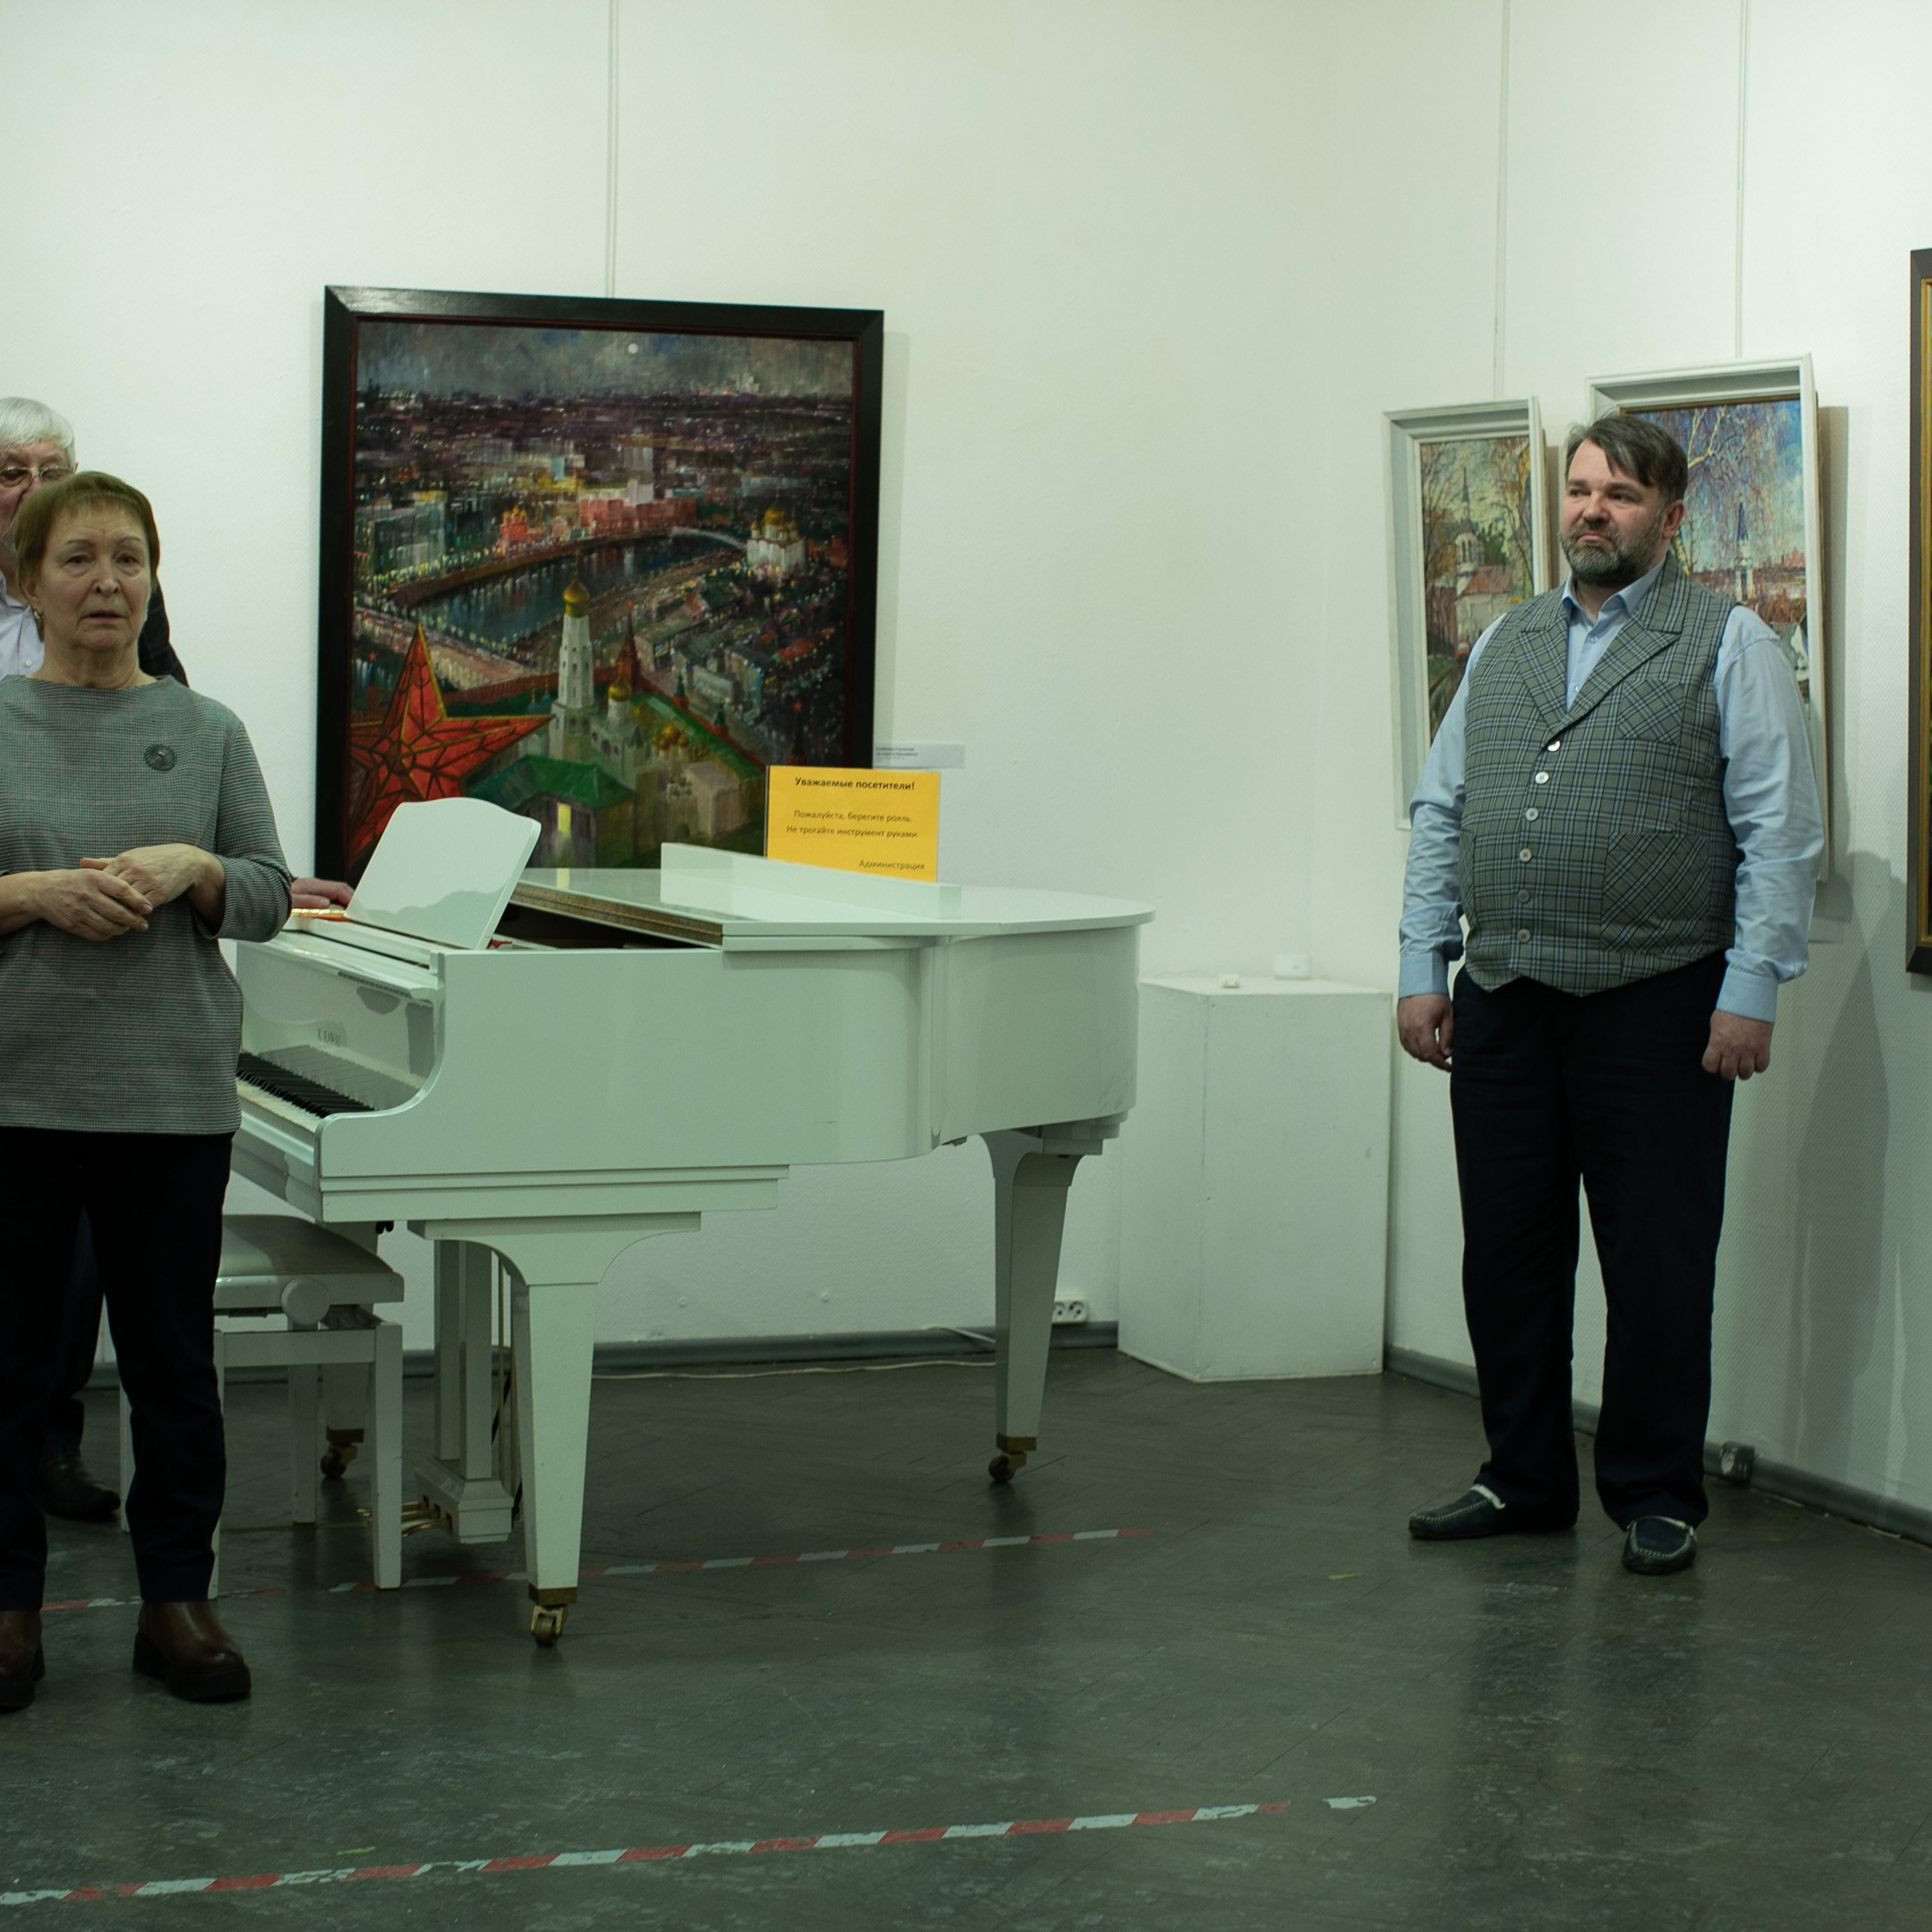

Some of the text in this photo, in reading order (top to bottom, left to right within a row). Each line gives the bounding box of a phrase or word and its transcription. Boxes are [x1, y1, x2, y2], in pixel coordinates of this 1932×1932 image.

[795, 777, 915, 791] Уважаемые посетители!
[794, 810, 913, 824] Пожалуйста, берегите рояль.
[786, 825, 919, 840] Не трогайте инструмент руками.
[859, 859, 925, 870] Администрация
